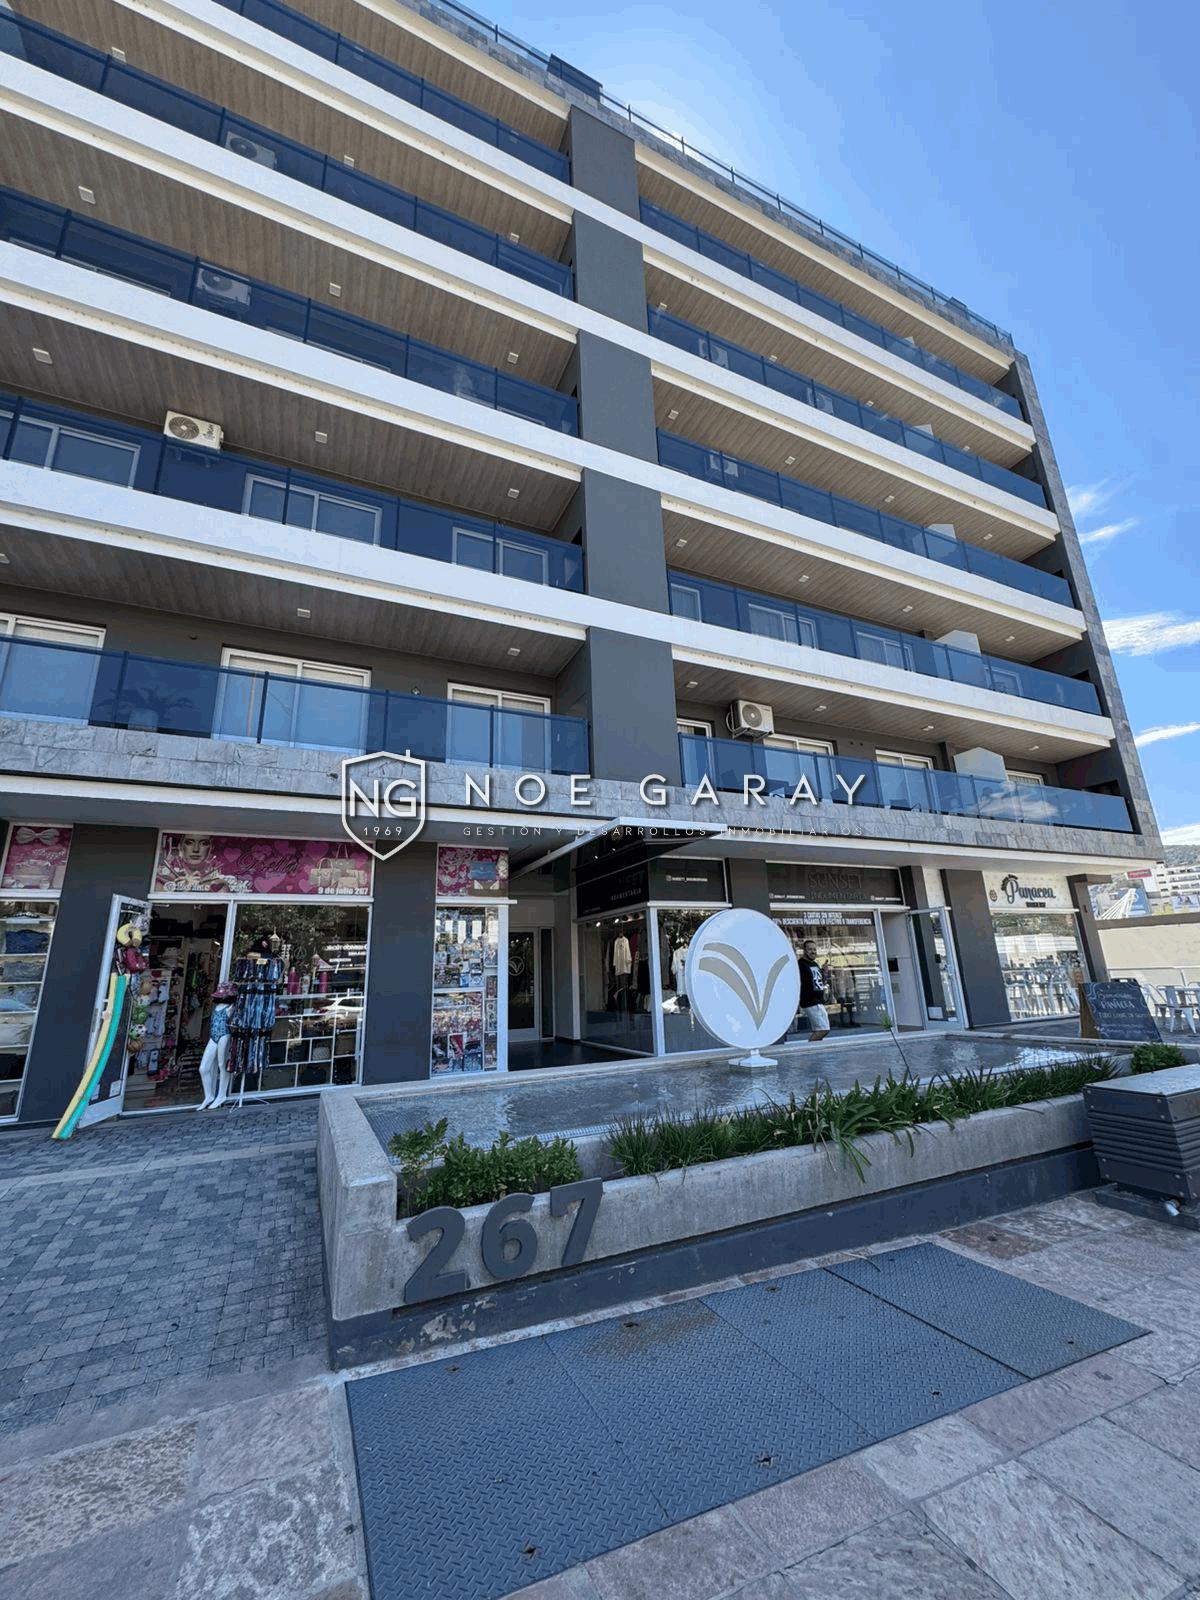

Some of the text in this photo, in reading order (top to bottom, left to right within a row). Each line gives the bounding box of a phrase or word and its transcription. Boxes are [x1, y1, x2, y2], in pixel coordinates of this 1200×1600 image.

[318, 886, 324, 895] 9
[324, 886, 335, 895] de
[335, 886, 354, 896] julio
[807, 871, 863, 890] SUNSET
[1005, 879, 1056, 904] Panacea
[404, 1177, 604, 1304] 267
